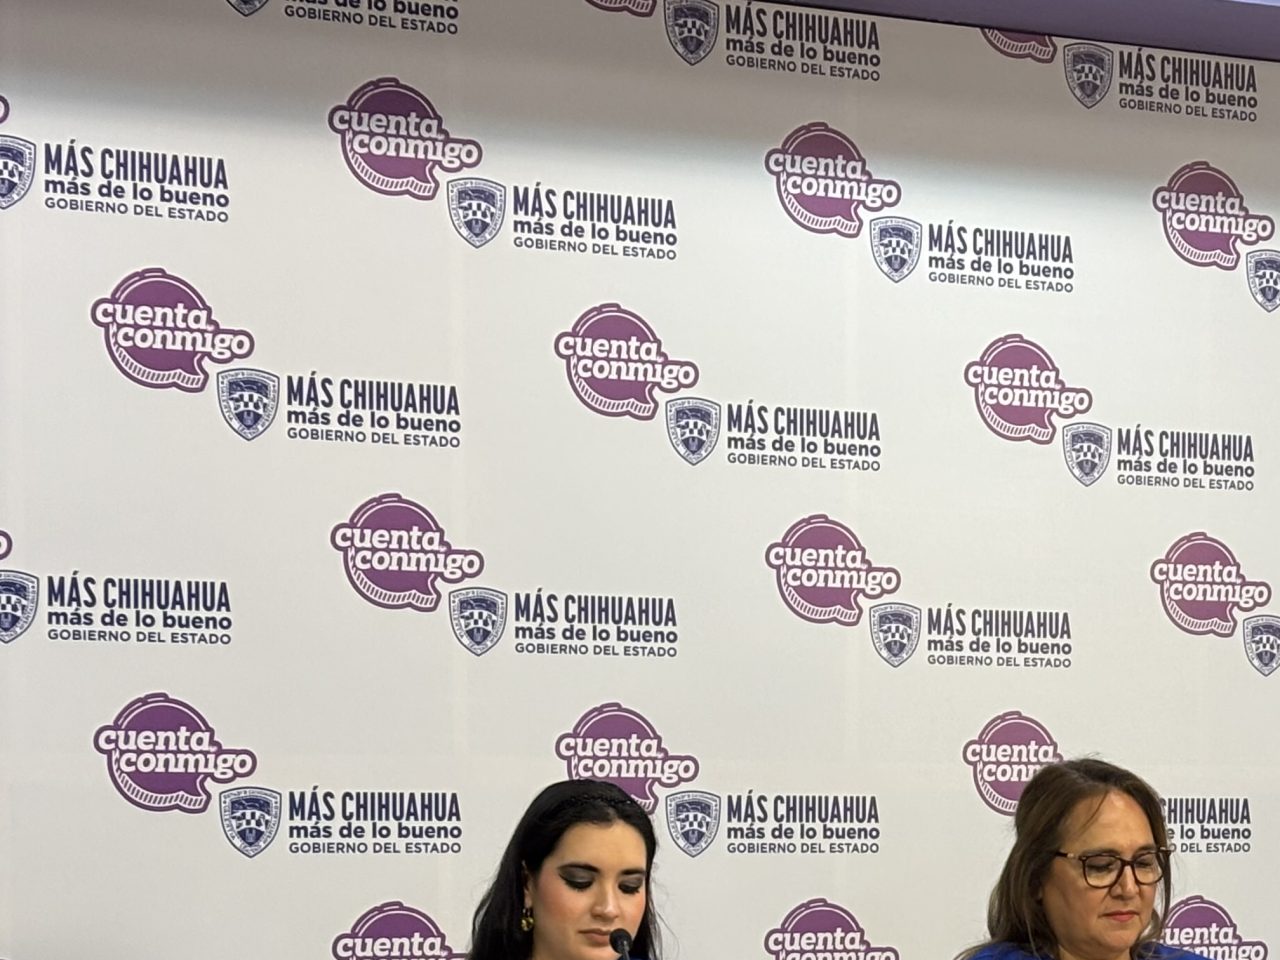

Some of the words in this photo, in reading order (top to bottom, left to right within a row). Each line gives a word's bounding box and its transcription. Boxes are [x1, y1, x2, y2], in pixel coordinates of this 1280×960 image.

[285, 5, 364, 25] GOBIERNO
[368, 14, 397, 29] DEL
[401, 17, 458, 35] ESTADO
[726, 2, 767, 38] MÁS
[773, 10, 880, 50] CHIHUAHUA
[726, 36, 765, 54] más
[770, 40, 794, 57] de
[800, 42, 818, 60] lo
[823, 45, 880, 67] bueno
[726, 54, 797, 72] GOBIERNO
[801, 62, 826, 76] DEL
[830, 66, 880, 82] ESTADO
[333, 110, 438, 138] cuenta
[45, 139, 94, 178] MÁS
[101, 148, 228, 190] CHIHUAHUA
[353, 135, 478, 168] conmigo
[769, 153, 862, 179] cuenta
[45, 177, 91, 196] más
[98, 180, 125, 198] de
[133, 182, 153, 201] lo
[160, 185, 229, 207] bueno
[787, 176, 898, 207] conmigo
[1156, 191, 1239, 215] cuenta
[45, 198, 128, 214] GOBIERNO
[134, 204, 163, 217] DEL
[168, 207, 228, 222] ESTADO
[1172, 211, 1271, 241] conmigo
[95, 303, 207, 329] cuenta
[117, 325, 250, 359] conmigo
[558, 336, 657, 361] cuenta
[577, 357, 695, 389] conmigo
[968, 365, 1055, 388] cuenta
[984, 384, 1089, 415] conmigo
[728, 400, 768, 434] MÁS
[774, 407, 880, 440] CHIHUAHUA
[728, 434, 766, 450] más
[772, 436, 795, 452] de
[801, 437, 818, 453] lo
[824, 438, 881, 457] bueno
[728, 453, 797, 466] GOBIERNO
[802, 457, 826, 468] DEL
[831, 458, 880, 471] ESTADO
[335, 526, 440, 551] cuenta
[355, 547, 480, 579] conmigo
[769, 545, 862, 568] cuenta
[787, 564, 897, 595] conmigo
[1154, 561, 1236, 583] cuenta
[515, 588, 558, 623] MÁS
[565, 594, 677, 626] CHIHUAHUA
[1170, 579, 1268, 608] conmigo
[515, 623, 556, 640] más
[562, 624, 586, 640] de
[592, 625, 610, 641] lo
[616, 626, 678, 643] bueno
[515, 643, 588, 654] GOBIERNO
[594, 645, 619, 656] DEL
[624, 646, 677, 657] ESTADO
[98, 726, 209, 751] cuenta
[559, 734, 658, 757] cuenta
[966, 741, 1054, 762] cuenta
[120, 746, 252, 779] conmigo
[578, 752, 695, 783] conmigo
[289, 786, 335, 821] MÁS
[342, 792, 461, 821] CHIHUAHUA
[289, 821, 332, 838] más
[339, 822, 365, 838] de
[372, 822, 391, 838] lo
[398, 822, 462, 838] bueno
[289, 842, 368, 853] GOBIERNO
[373, 842, 400, 853] DEL
[406, 842, 461, 853] ESTADO
[337, 932, 441, 957] cuenta
[768, 927, 860, 951] cuenta
[1160, 923, 1234, 945] uenta
